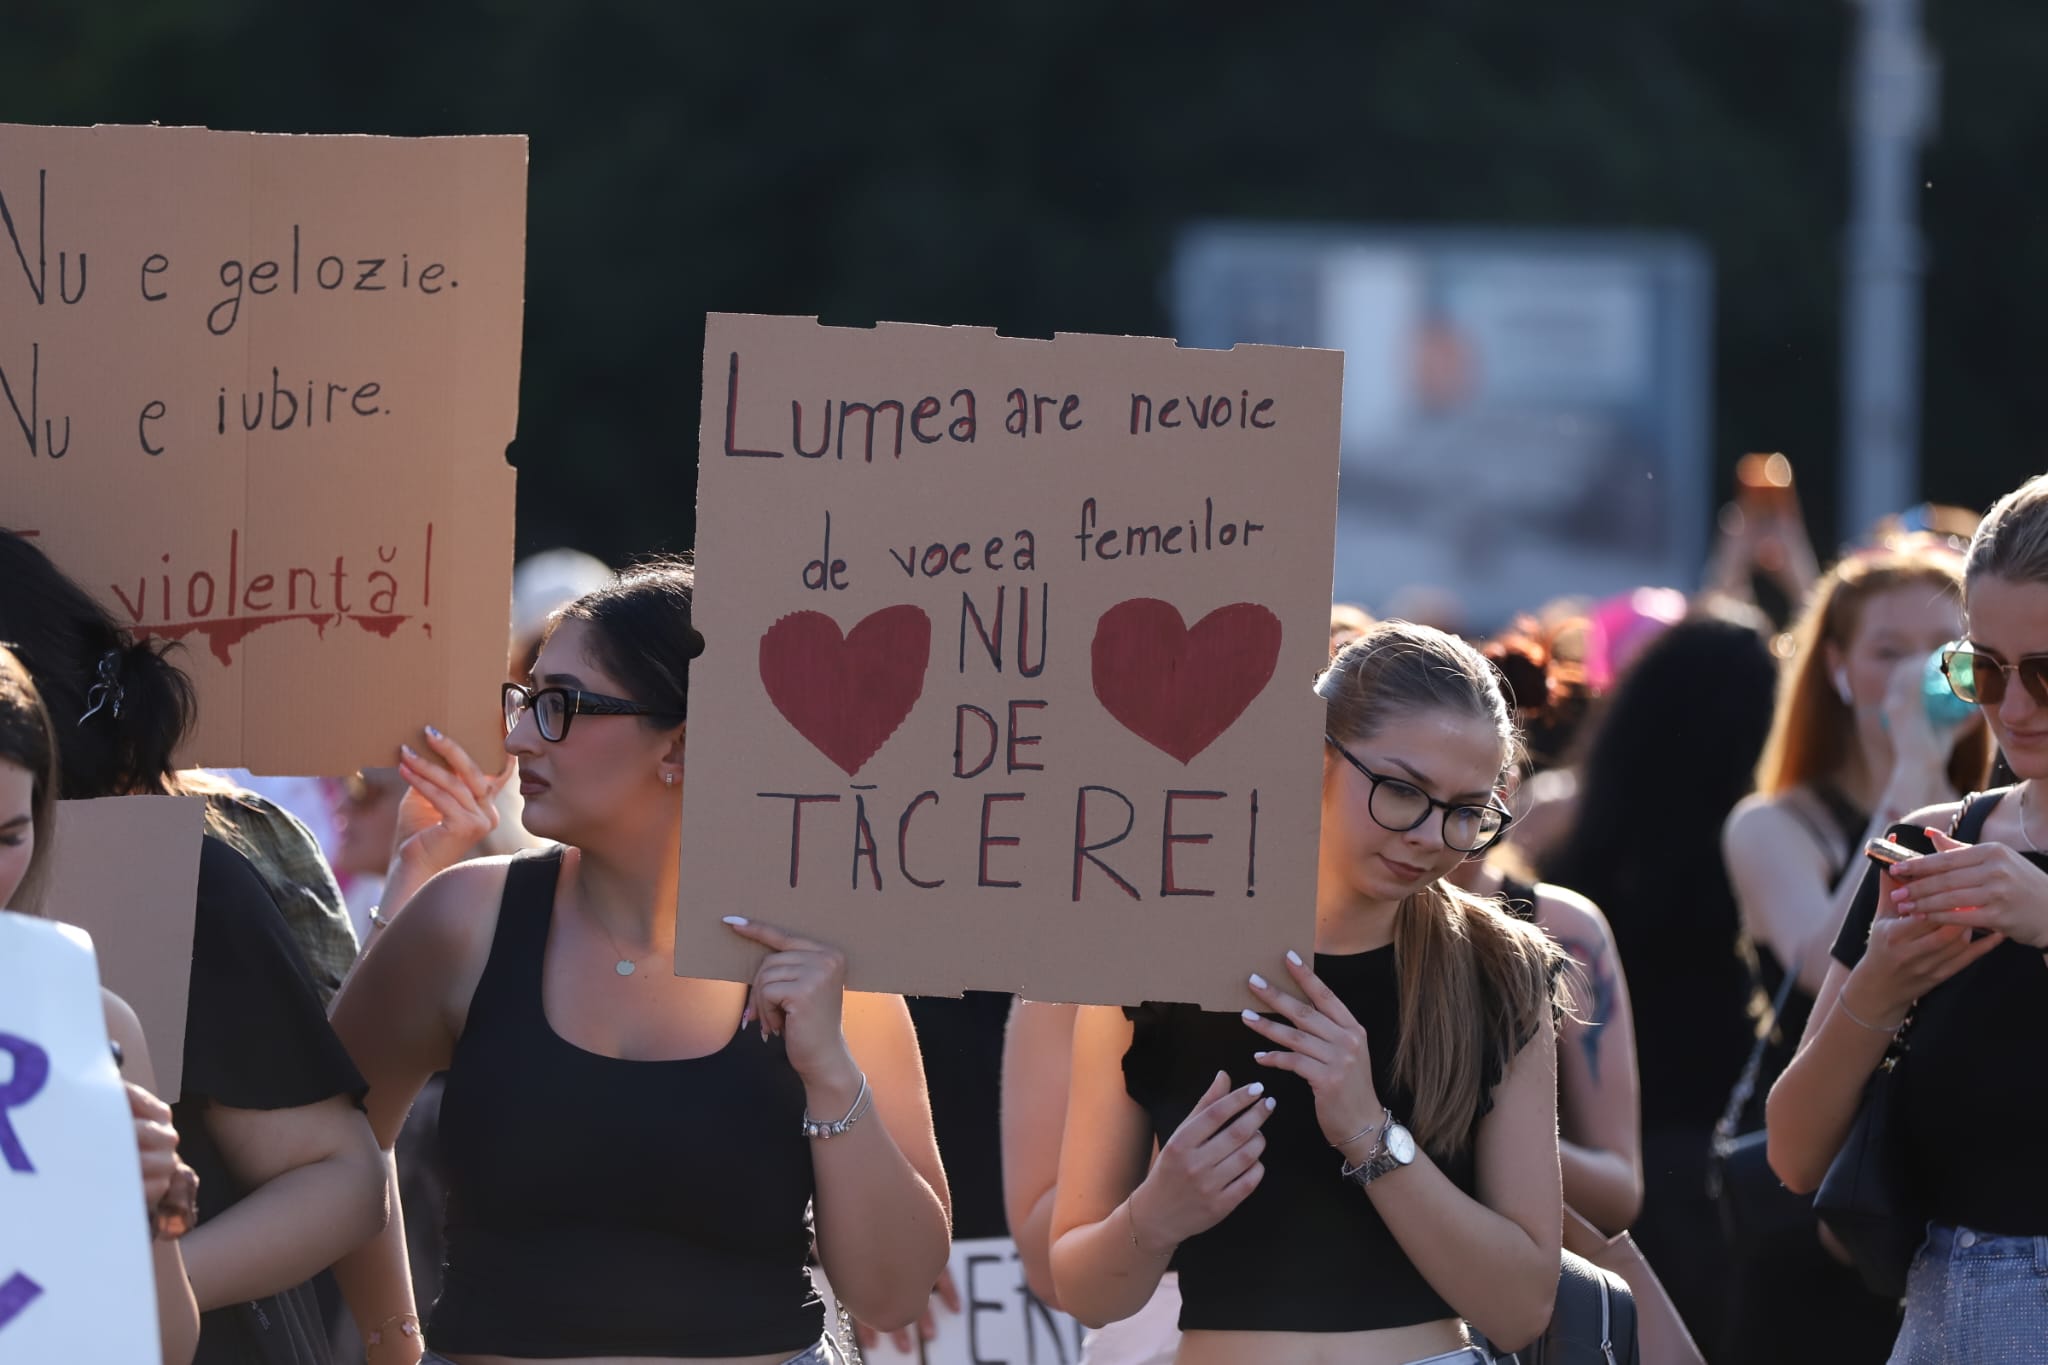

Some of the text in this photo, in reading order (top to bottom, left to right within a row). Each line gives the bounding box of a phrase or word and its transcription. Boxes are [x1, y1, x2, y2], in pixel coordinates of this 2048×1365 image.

[0, 169, 459, 335] Nu e gelozie.
[0, 342, 391, 458] Nu e iubire.
[724, 351, 1276, 463] Lumea are nevoie
[802, 497, 1265, 591] de vocea femeilor
[959, 582, 1049, 678] NU
[952, 699, 1049, 779] DE
